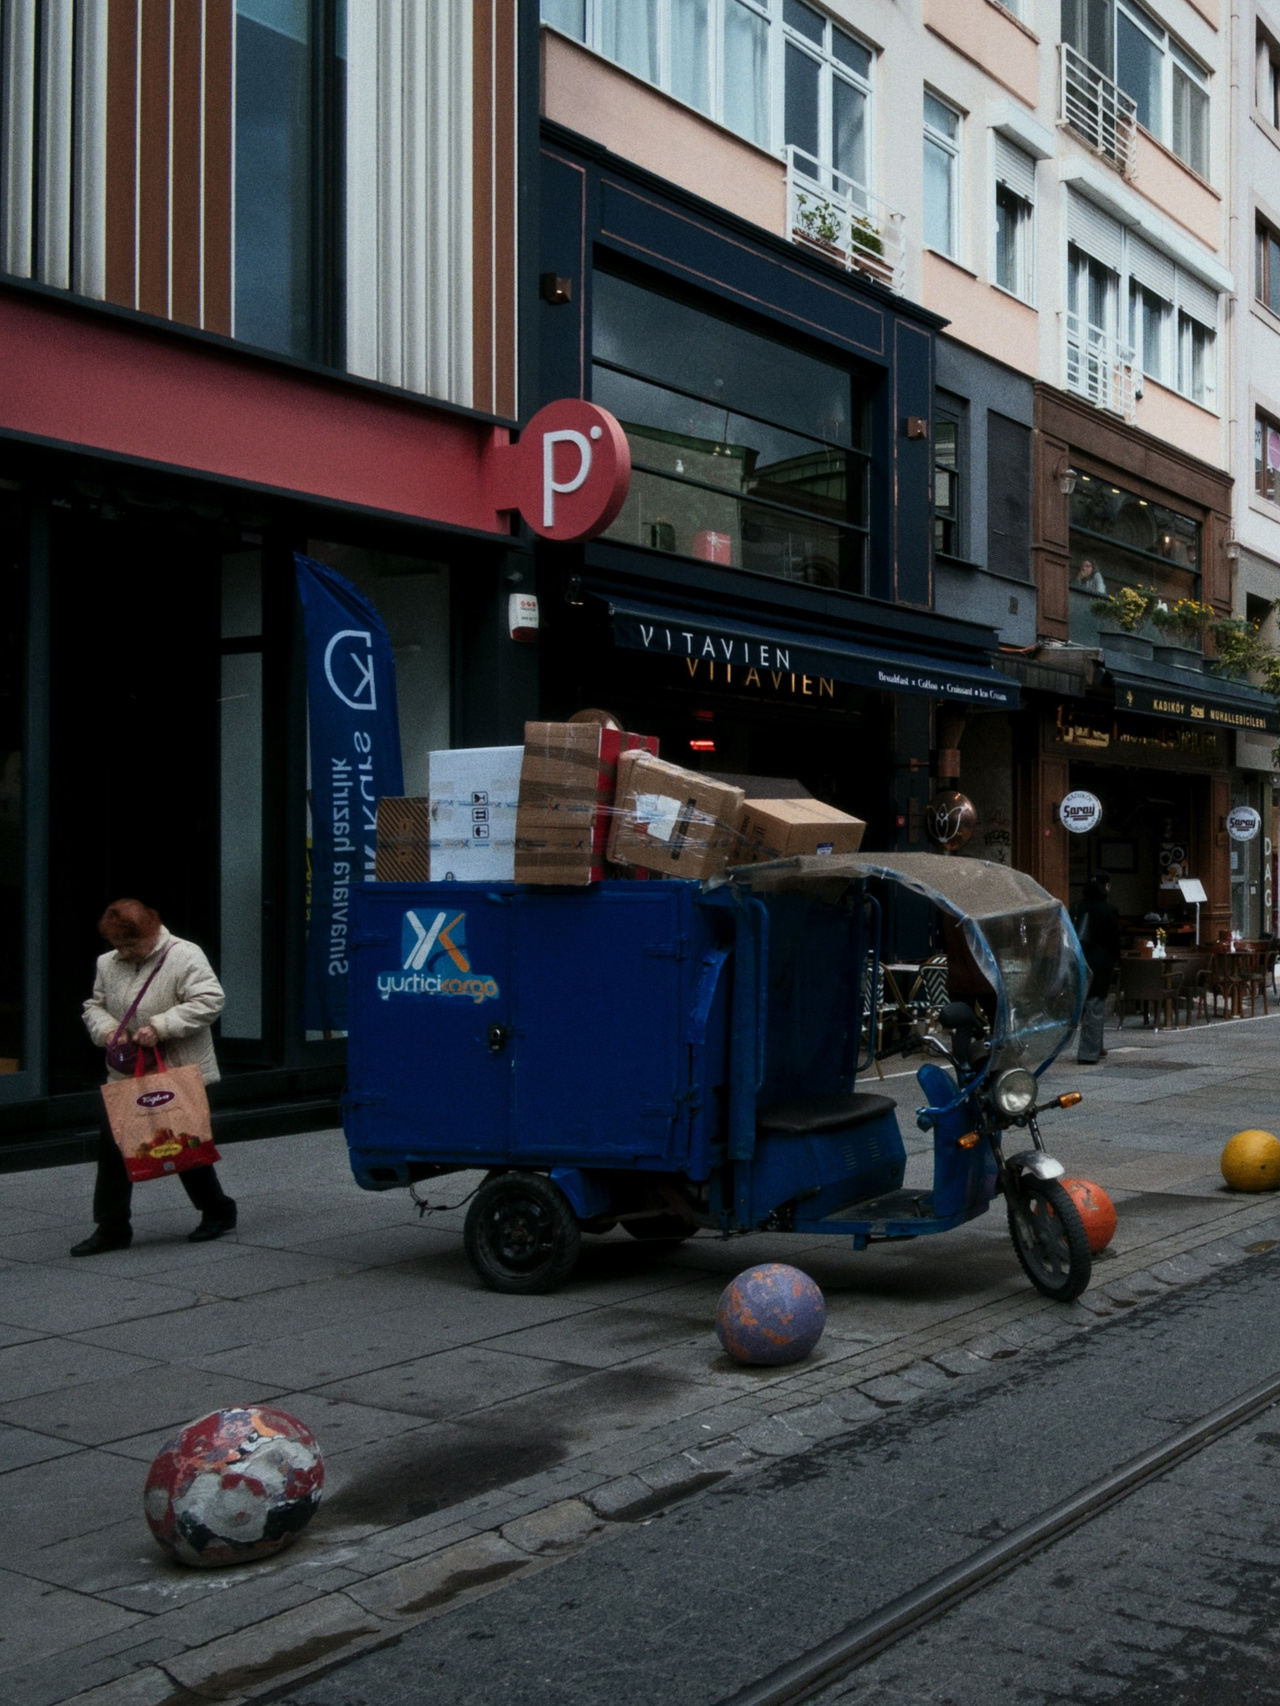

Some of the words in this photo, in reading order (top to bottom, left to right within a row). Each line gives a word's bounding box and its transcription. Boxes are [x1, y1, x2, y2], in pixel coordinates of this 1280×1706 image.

[640, 624, 790, 670] VITAVIEN
[686, 656, 835, 699] VITAVIEN
[1153, 699, 1185, 714] KADIKÖY
[1063, 804, 1096, 818] Saray
[1229, 817, 1257, 829] Saray
